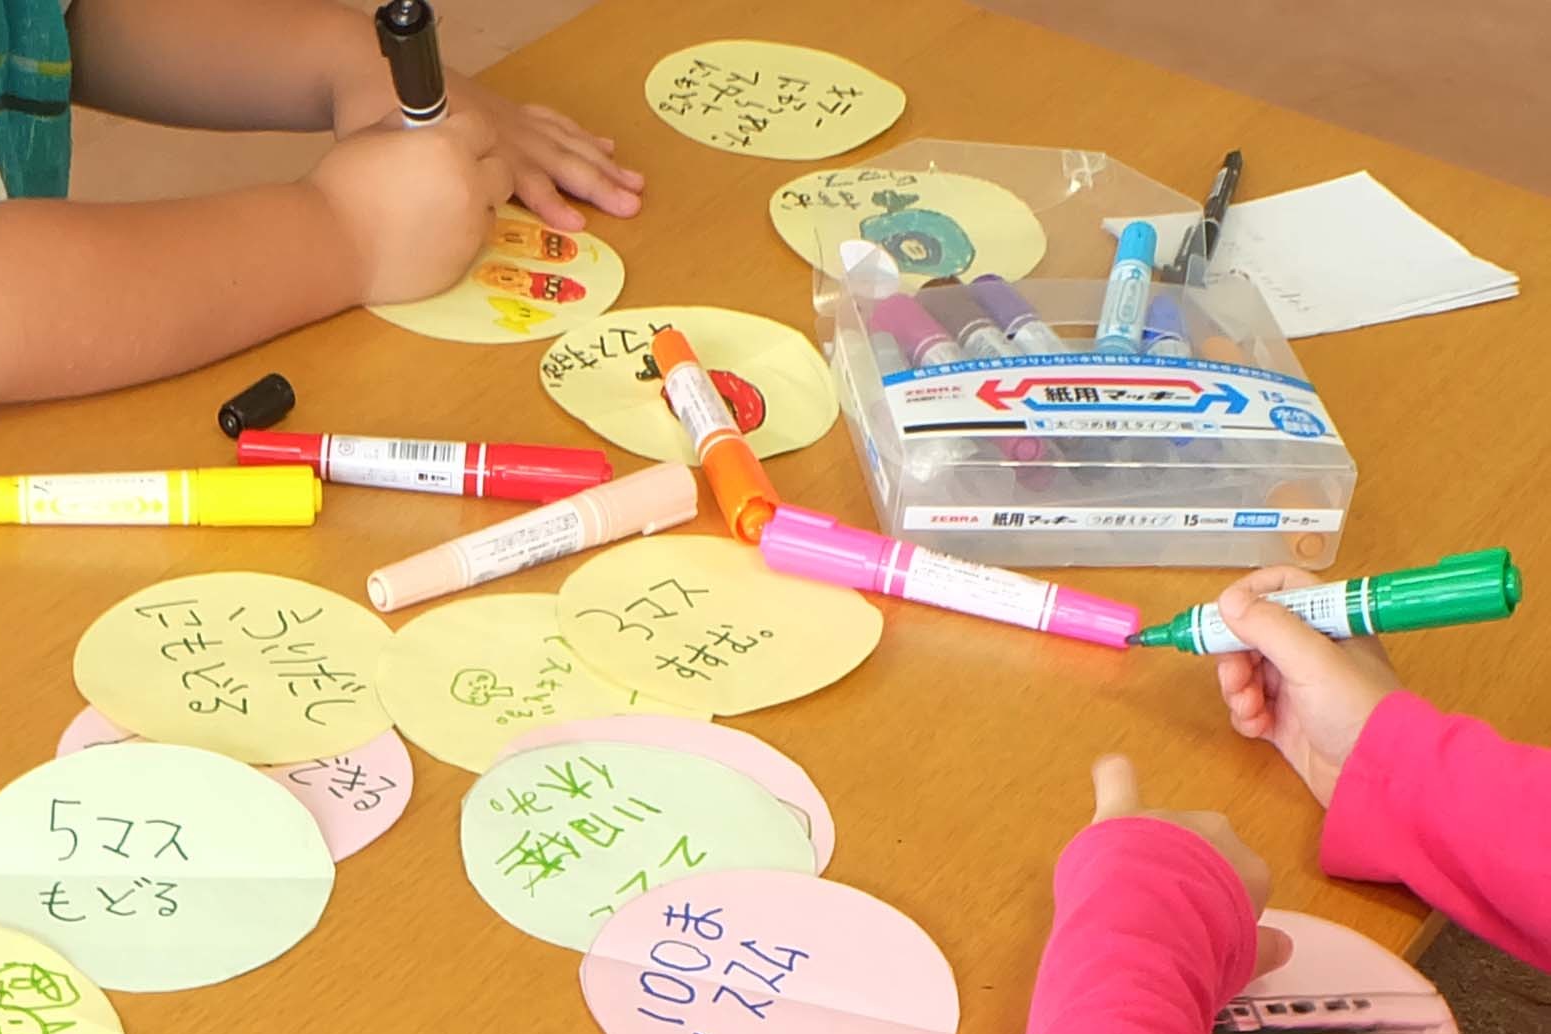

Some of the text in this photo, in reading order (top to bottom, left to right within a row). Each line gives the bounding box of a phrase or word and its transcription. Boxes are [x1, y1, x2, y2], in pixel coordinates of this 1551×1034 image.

[1044, 386, 1194, 404] 紙用マッキー
[930, 514, 980, 524] ZEBRA
[992, 512, 1078, 528] 紙用マッキー
[1182, 514, 1200, 528] 15
[1281, 517, 1321, 527] マーカー
[134, 599, 249, 715] にもどる
[229, 606, 367, 726] ふりだし
[49, 798, 189, 861] 5マス
[39, 876, 179, 922] もどる
